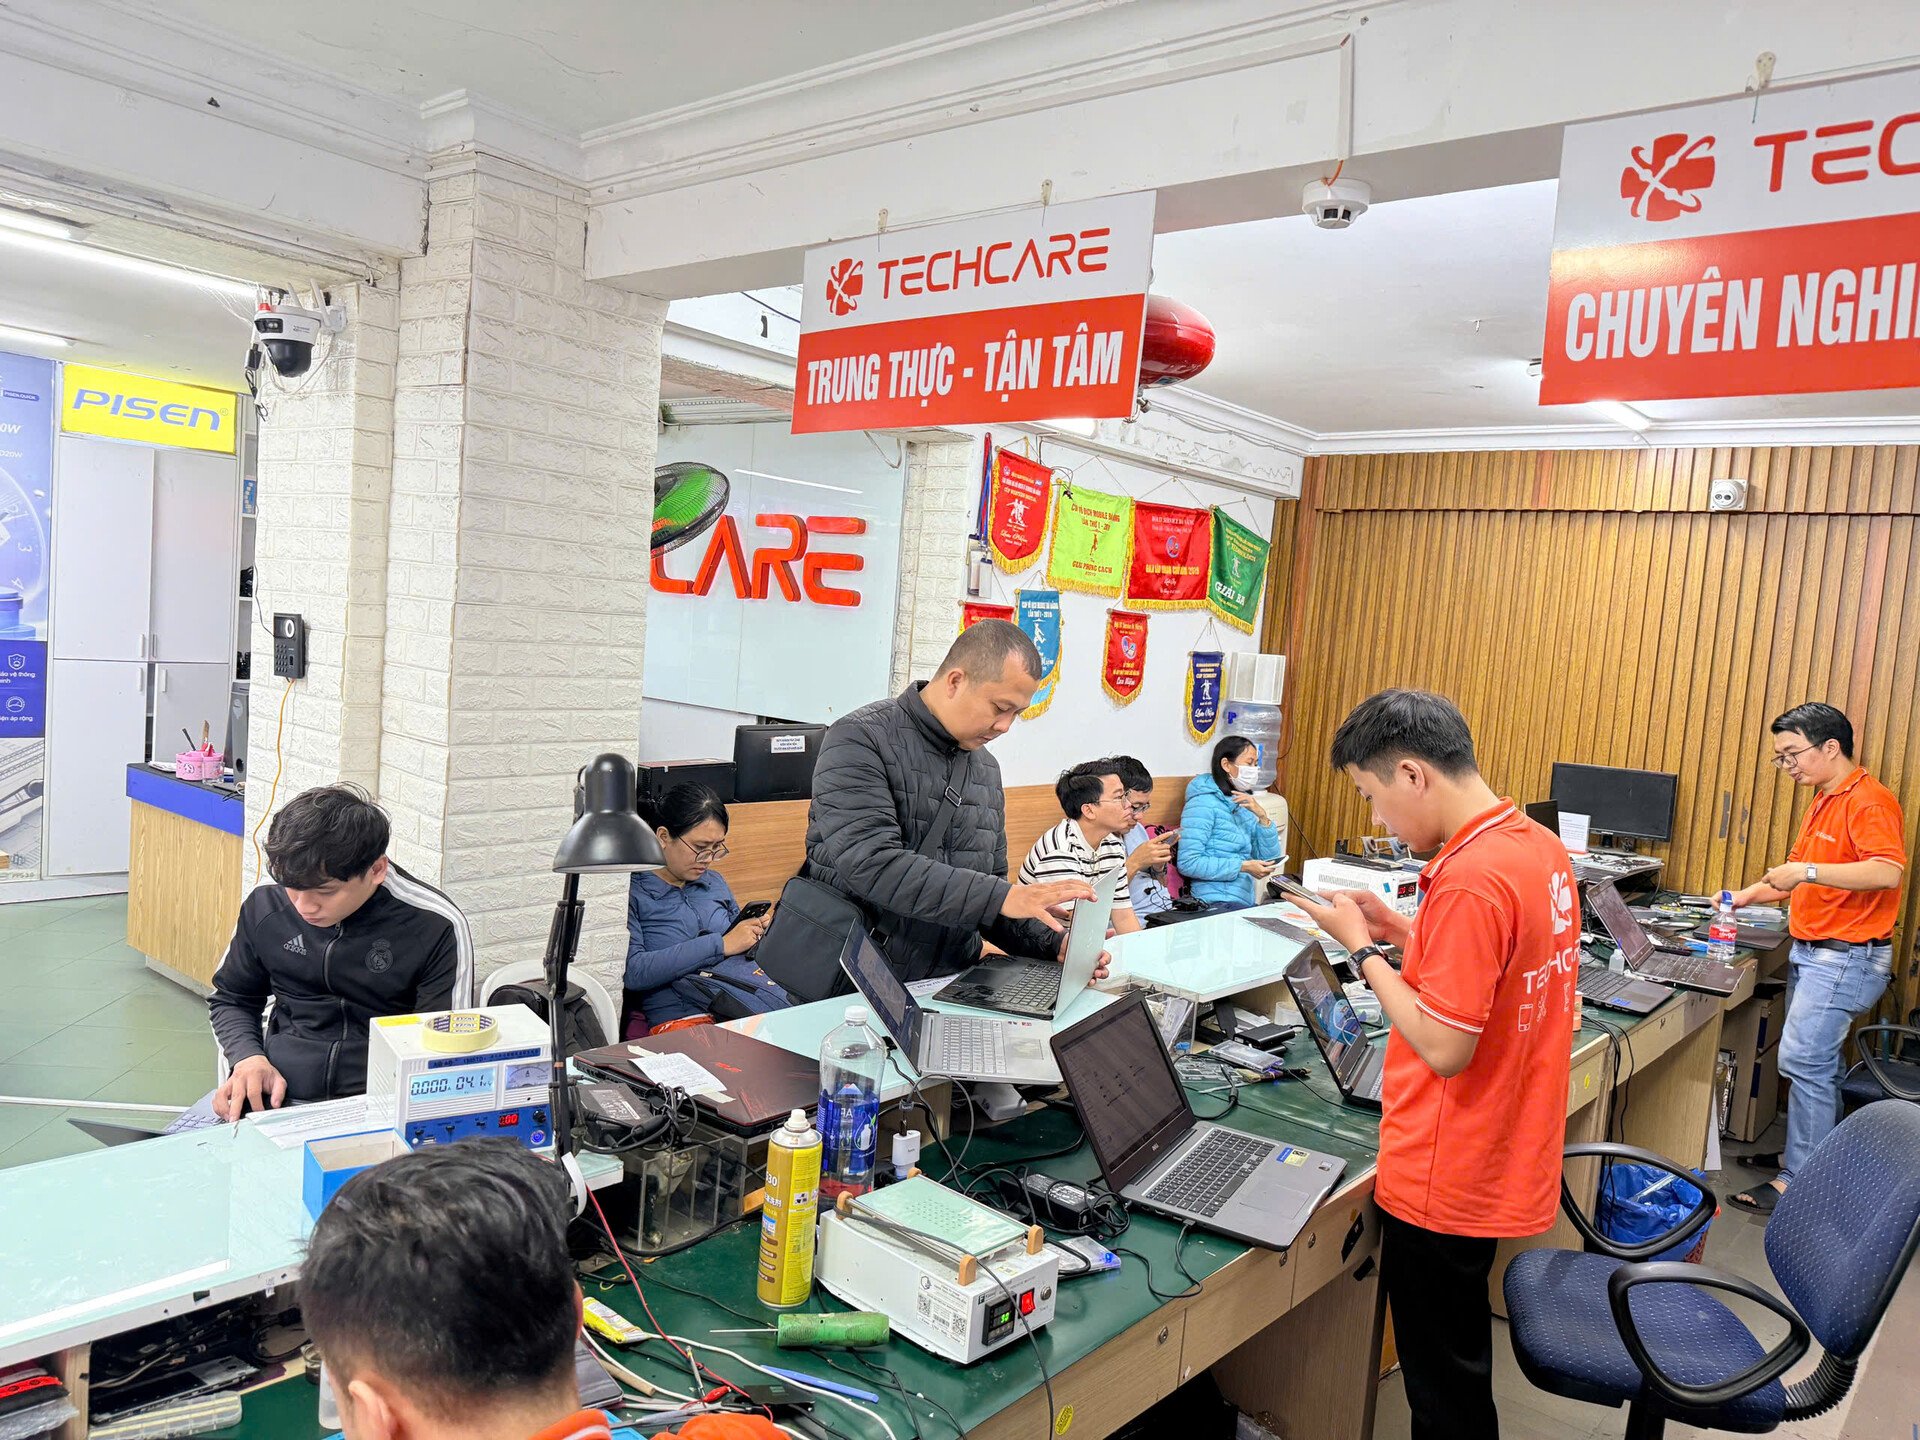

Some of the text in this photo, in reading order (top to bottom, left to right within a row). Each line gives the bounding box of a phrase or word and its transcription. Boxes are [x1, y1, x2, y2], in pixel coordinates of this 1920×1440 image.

[877, 227, 1110, 299] TECHCARE
[1565, 262, 1920, 362] CHUYÊN NGHI
[806, 354, 880, 405] TRUNG
[888, 342, 955, 407] THỰC
[984, 329, 1043, 403] TẬN
[1052, 322, 1124, 388] TÂM
[72, 389, 221, 431] PISEN
